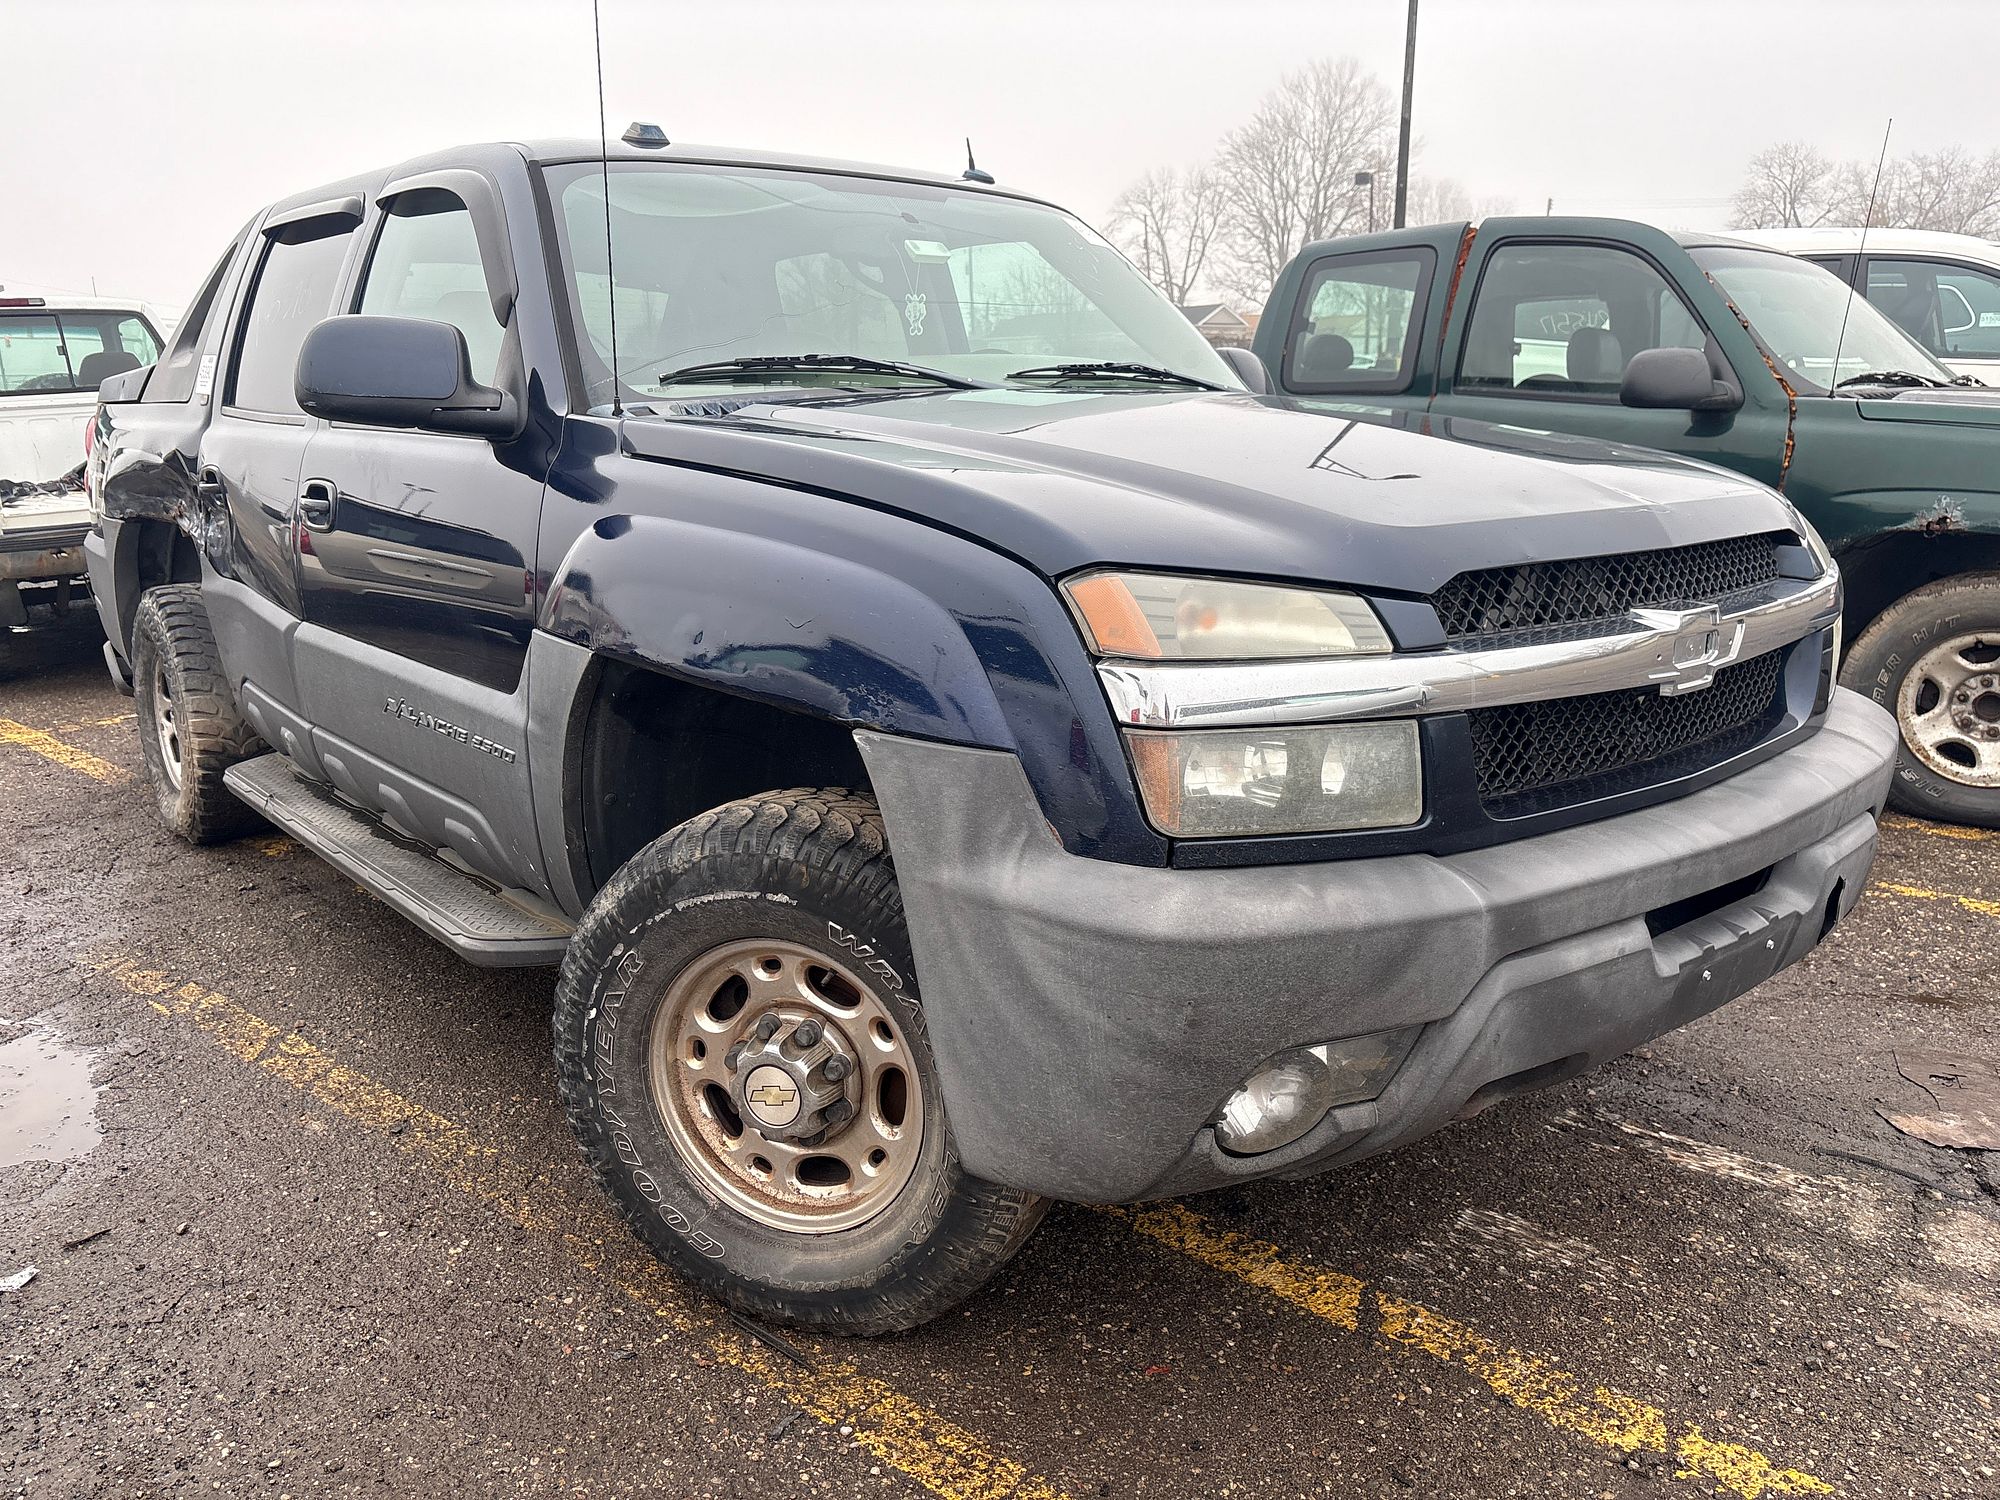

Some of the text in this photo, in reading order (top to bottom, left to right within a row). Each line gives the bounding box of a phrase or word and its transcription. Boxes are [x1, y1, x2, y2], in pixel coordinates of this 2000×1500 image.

[382, 696, 517, 765] AVALANCHE 2500
[594, 949, 725, 1259] GOODYEAR
